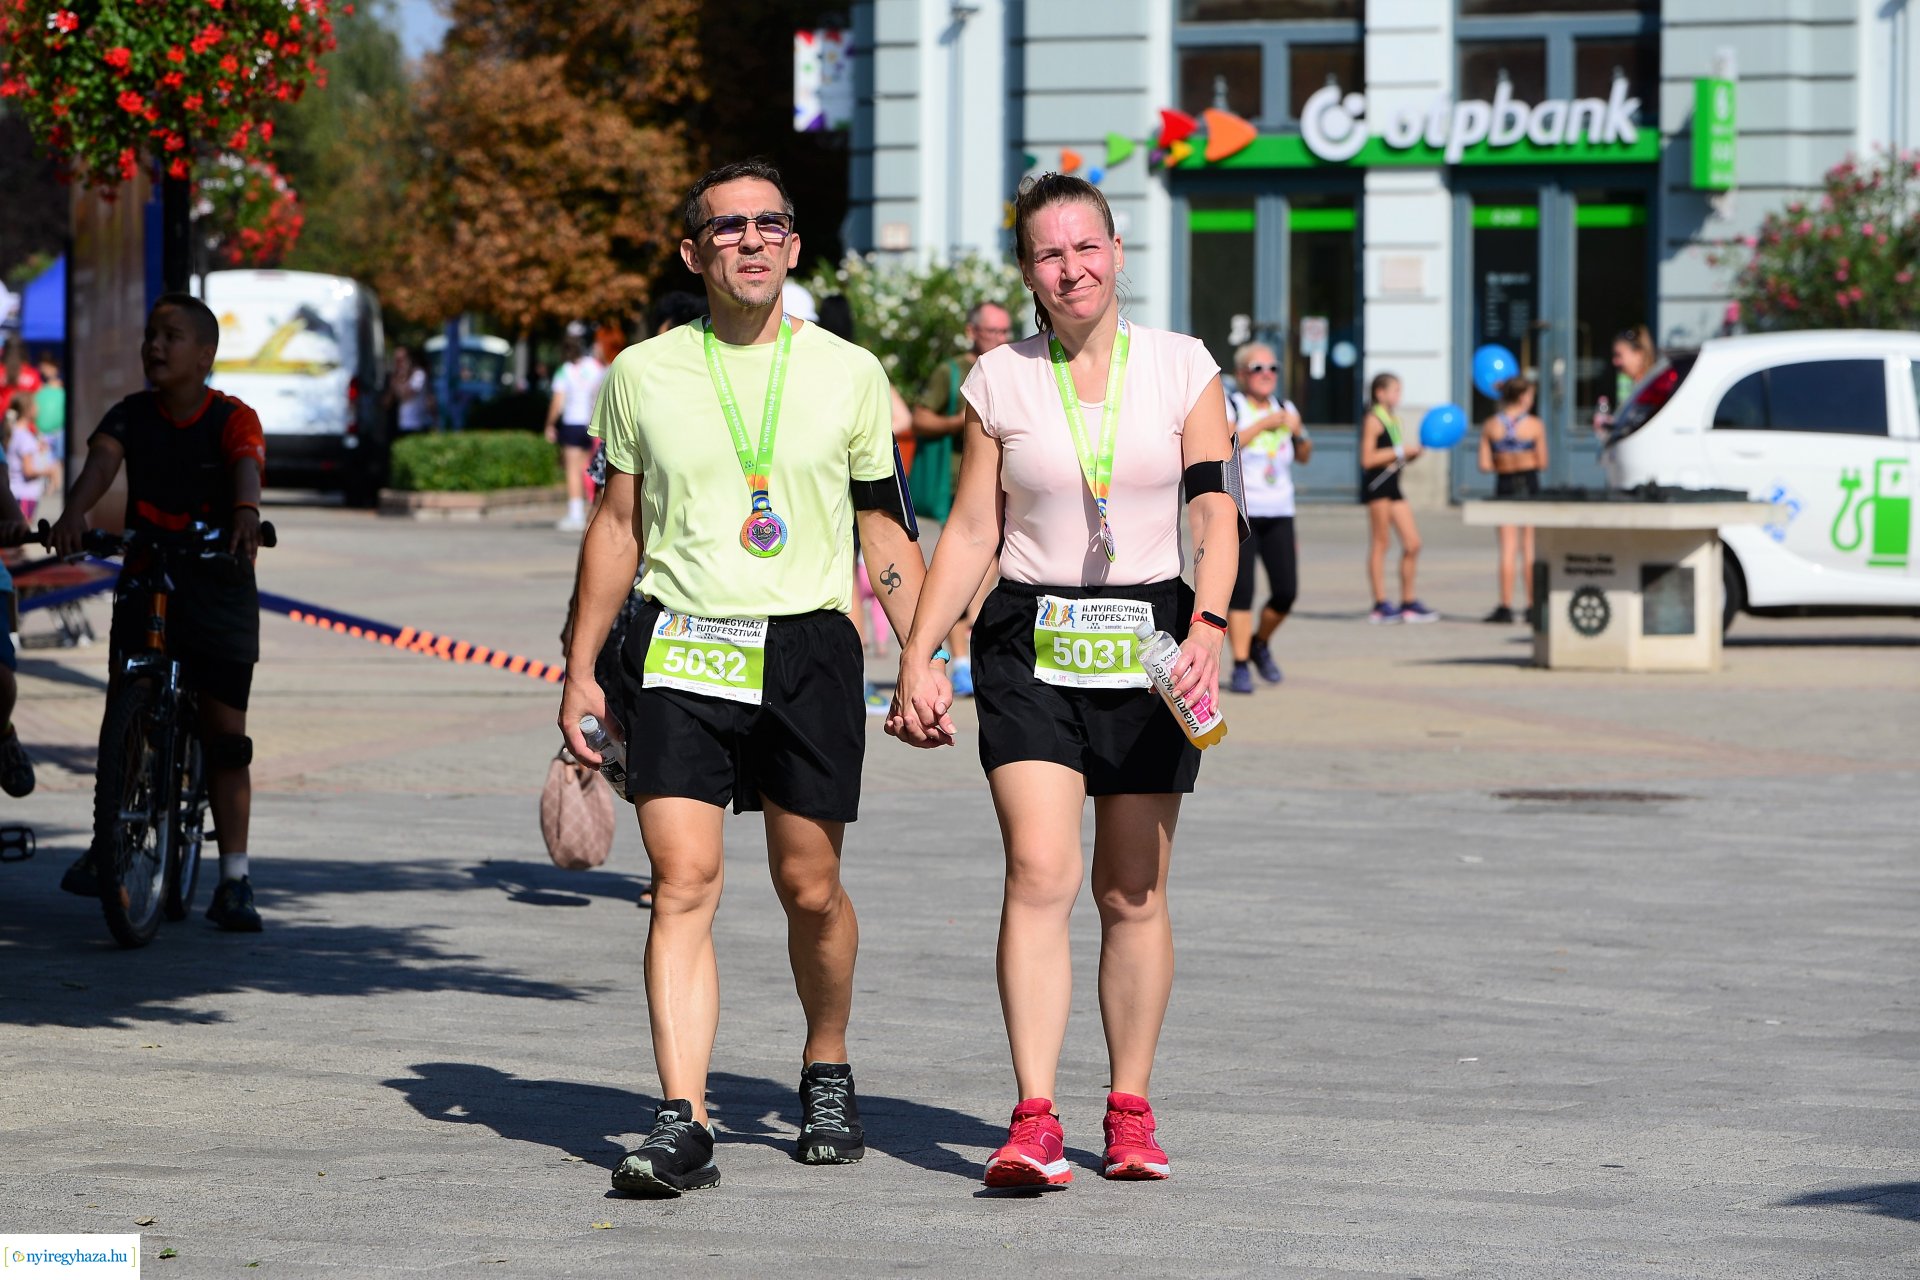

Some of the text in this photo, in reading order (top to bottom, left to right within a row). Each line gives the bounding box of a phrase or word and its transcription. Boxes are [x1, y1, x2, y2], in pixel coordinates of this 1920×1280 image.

[1384, 77, 1640, 164] otpbank
[663, 646, 747, 683] 5032
[1053, 636, 1131, 668] 5031
